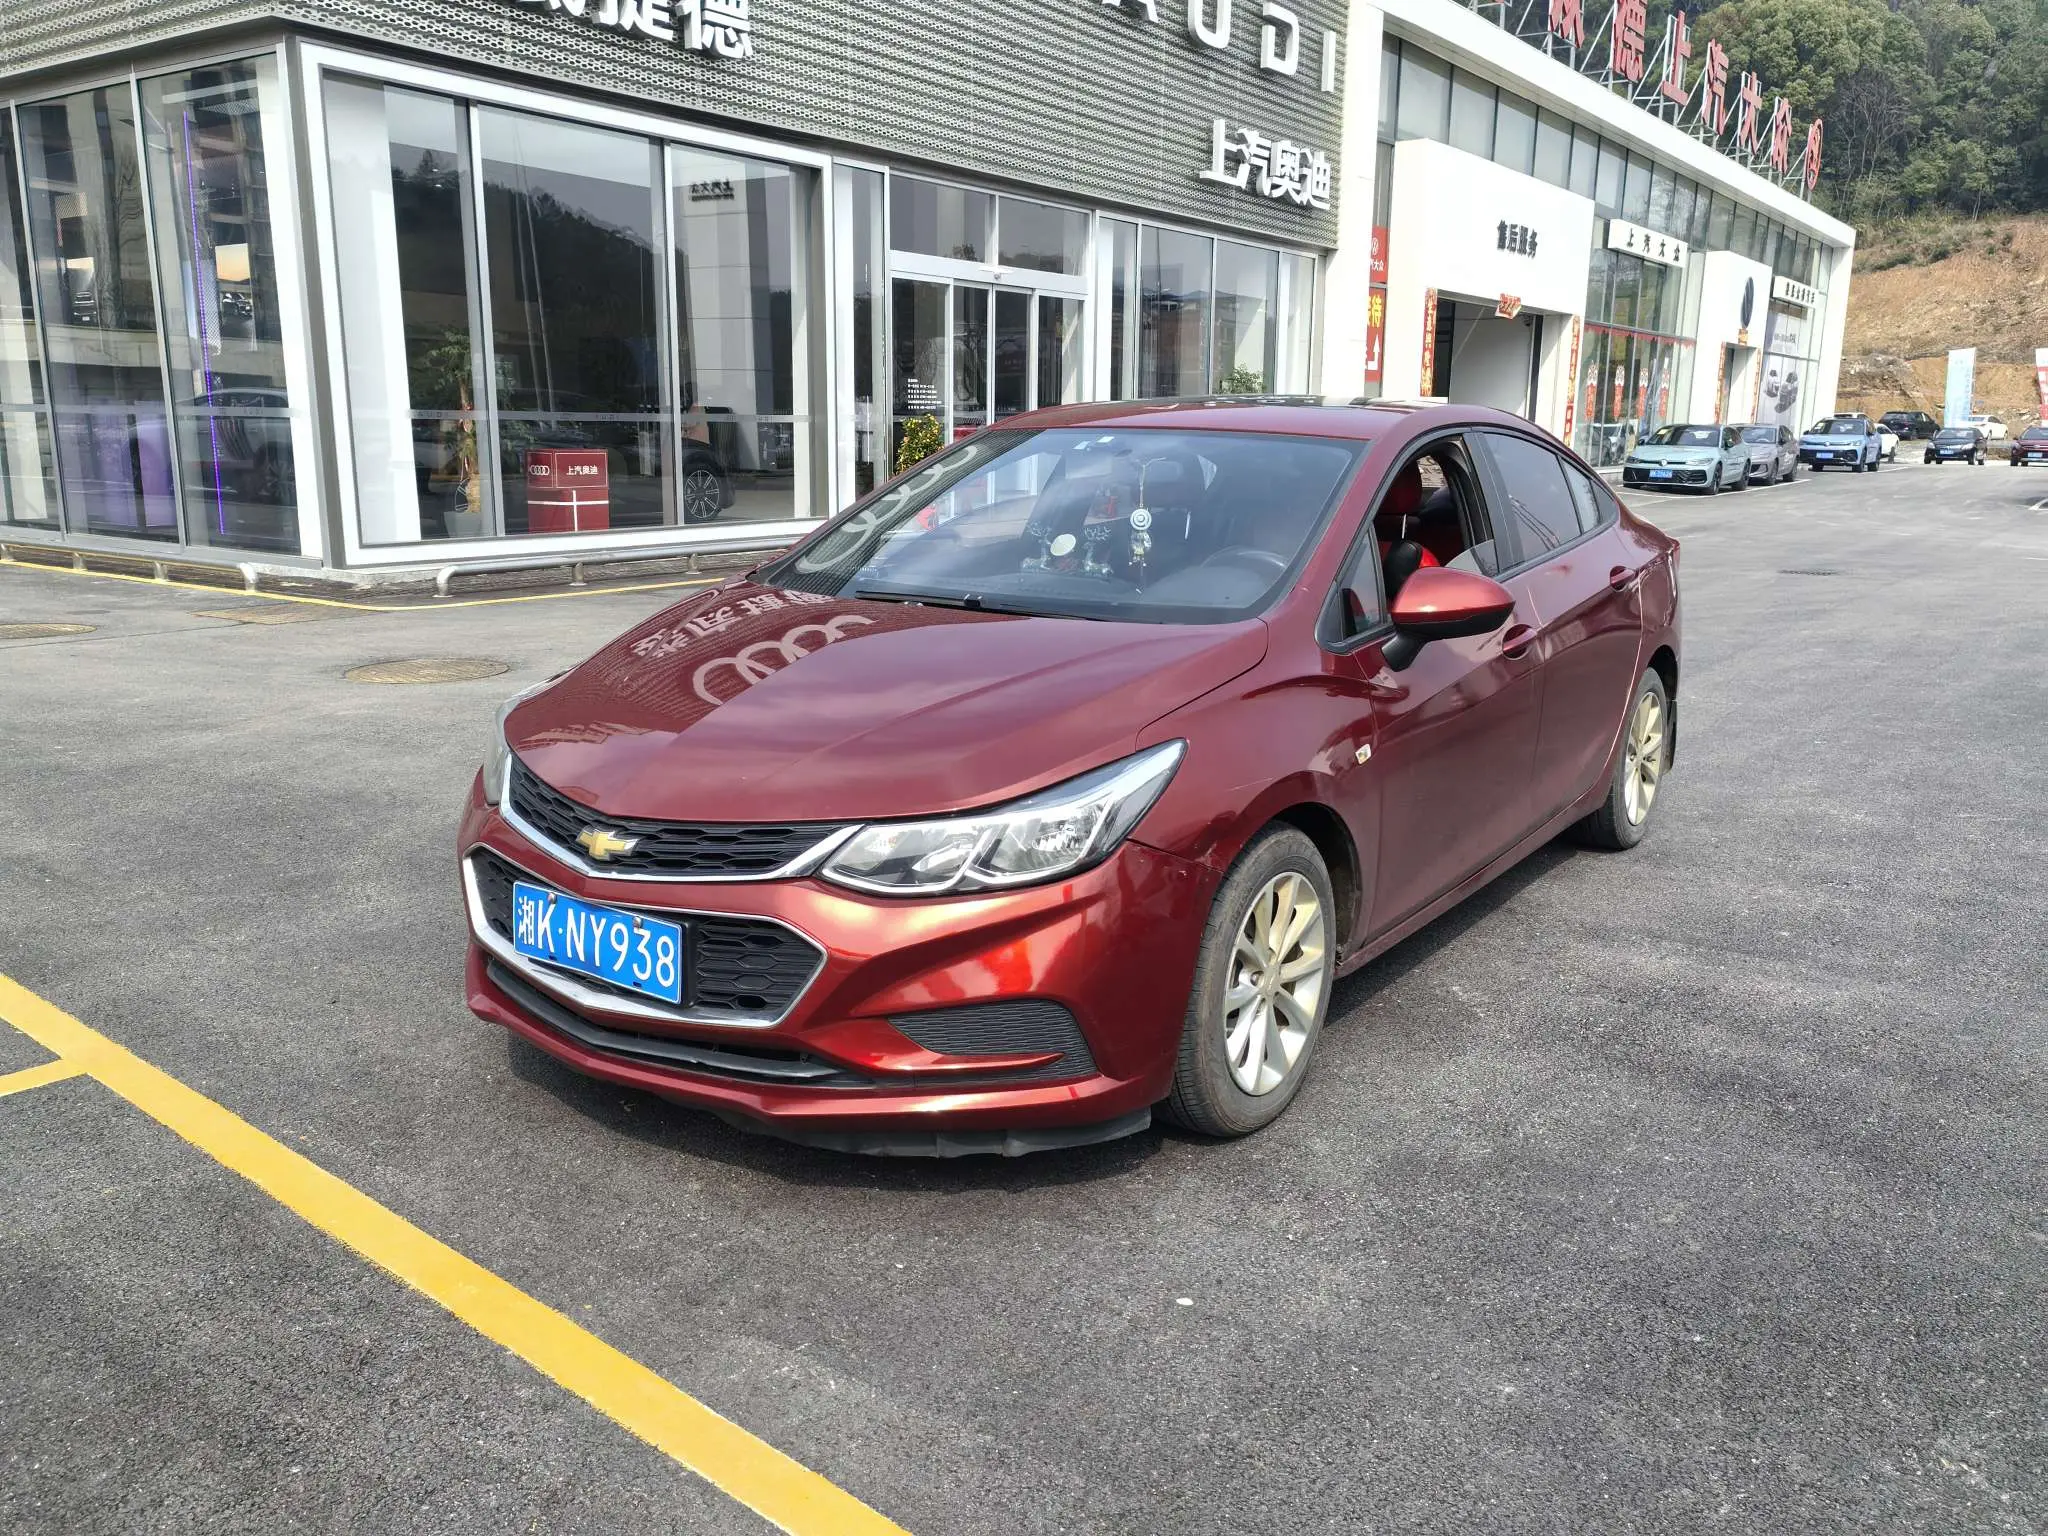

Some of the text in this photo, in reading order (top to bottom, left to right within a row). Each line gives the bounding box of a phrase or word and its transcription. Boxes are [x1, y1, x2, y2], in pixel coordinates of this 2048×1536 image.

[1104, 0, 1336, 92] UDI
[1200, 118, 1330, 210] 上汽奥迪
[1497, 220, 1537, 259] 售后服务
[1627, 228, 1680, 262] 上汽大众
[566, 465, 598, 475] 上汽奥迪
[518, 896, 675, 987] 湘K·NY938
